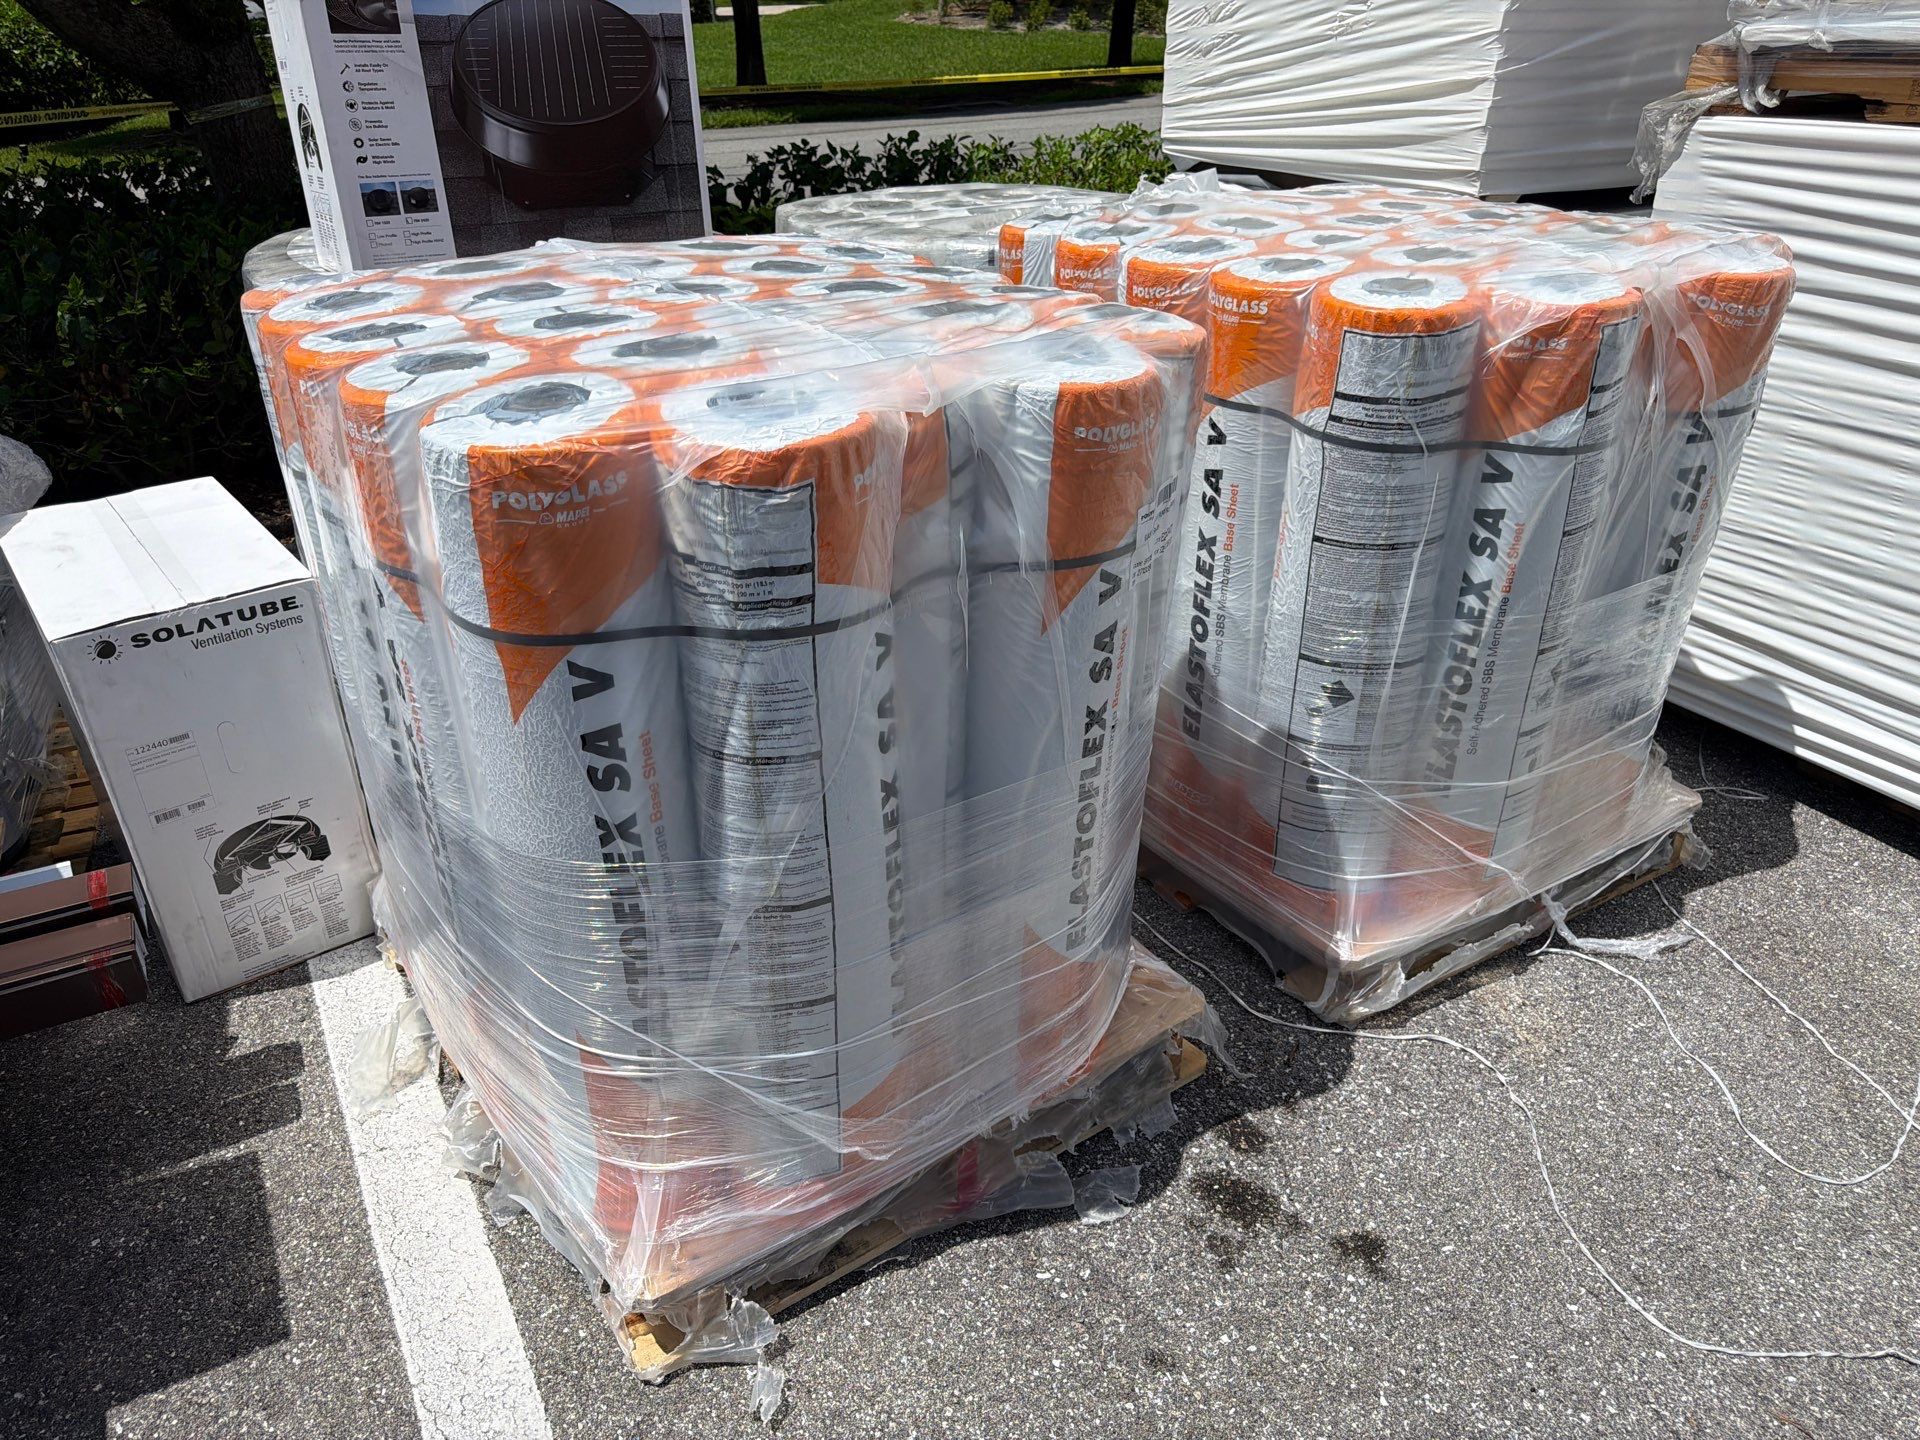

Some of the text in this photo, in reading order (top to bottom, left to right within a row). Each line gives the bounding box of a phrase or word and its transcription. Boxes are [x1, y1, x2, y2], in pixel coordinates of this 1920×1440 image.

[1226, 482, 1241, 523] Sheet
[1222, 523, 1236, 553] Base
[1099, 567, 1122, 607] V
[1181, 417, 1227, 742] ELASTOFLEX SA V
[130, 595, 299, 650] SOLATUBE
[191, 612, 304, 651] Ventilation Systems
[1214, 610, 1226, 639] SBS
[1423, 452, 1514, 799] ELASTOFLEX SA V
[1467, 521, 1526, 756] Self-Adhered SBS Membrane Base Sheet
[1089, 619, 1120, 684] SA
[566, 659, 616, 702] V
[134, 739, 169, 755] 122440
[581, 722, 632, 793] SA
[638, 728, 658, 783] Sheet
[641, 780, 663, 825] Base
